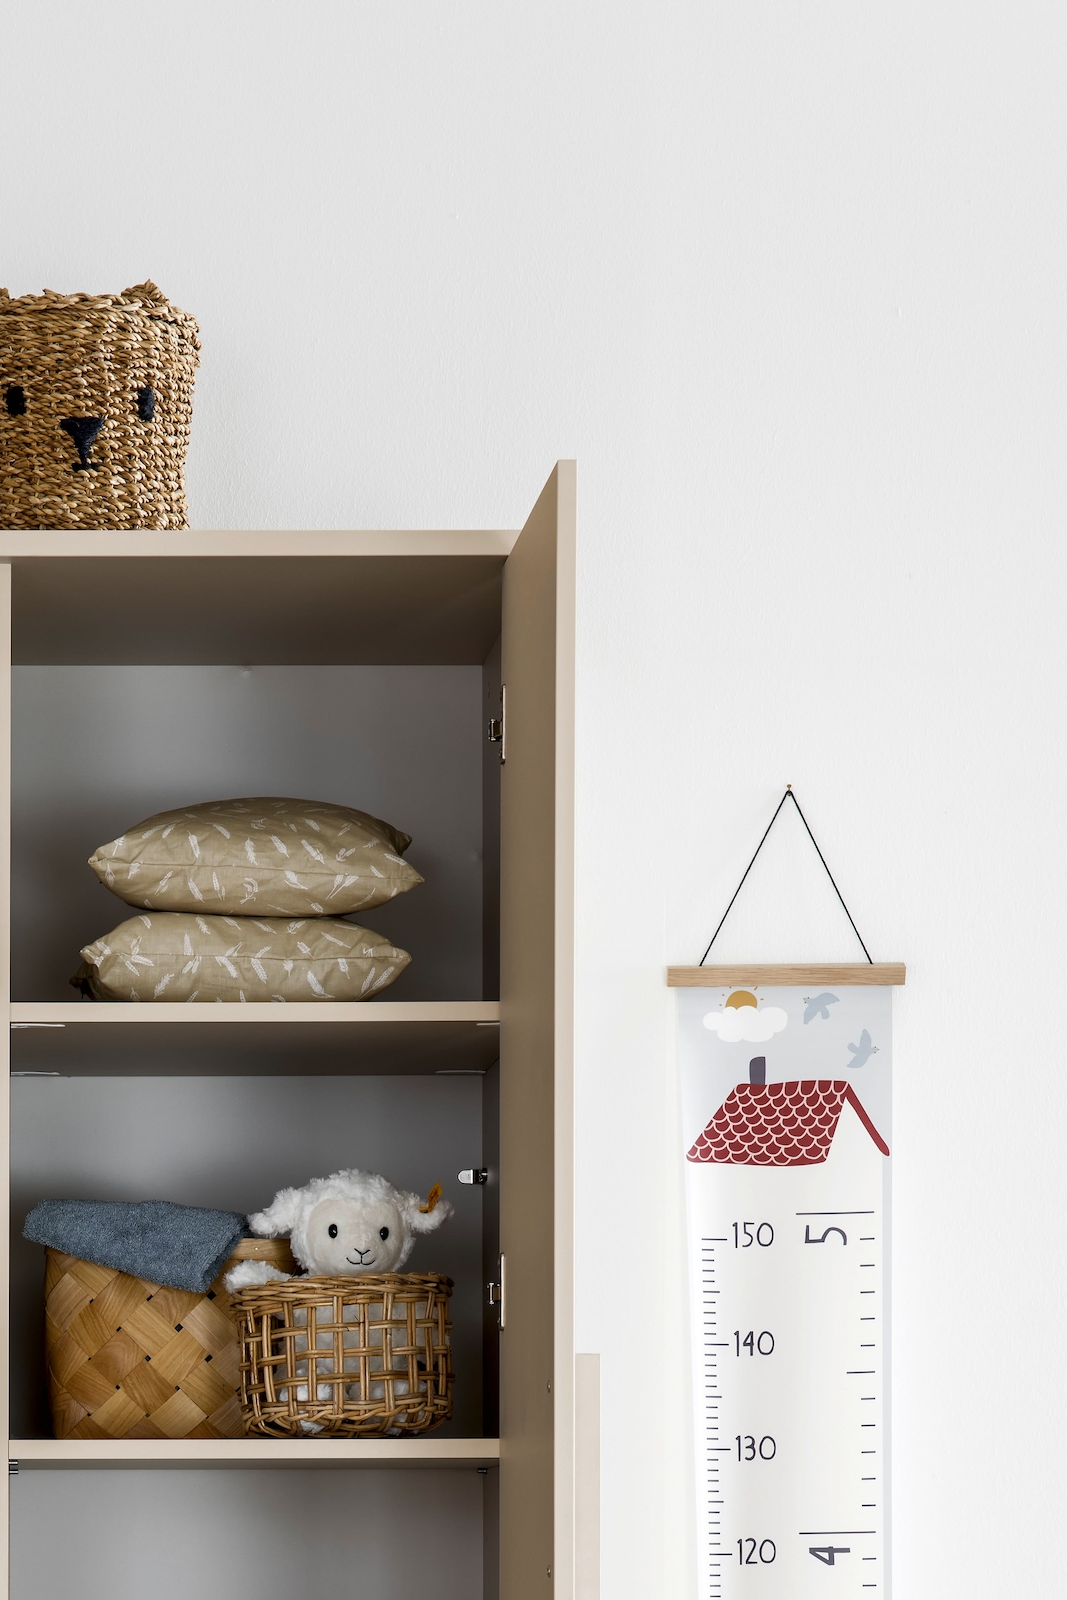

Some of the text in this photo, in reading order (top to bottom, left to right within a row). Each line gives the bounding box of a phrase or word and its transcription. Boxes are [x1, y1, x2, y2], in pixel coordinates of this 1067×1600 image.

[732, 1221, 775, 1249] 150
[804, 1224, 848, 1246] 5
[733, 1330, 775, 1357] 140
[735, 1435, 777, 1462] 130
[736, 1537, 777, 1566] 120
[808, 1545, 851, 1566] 4
